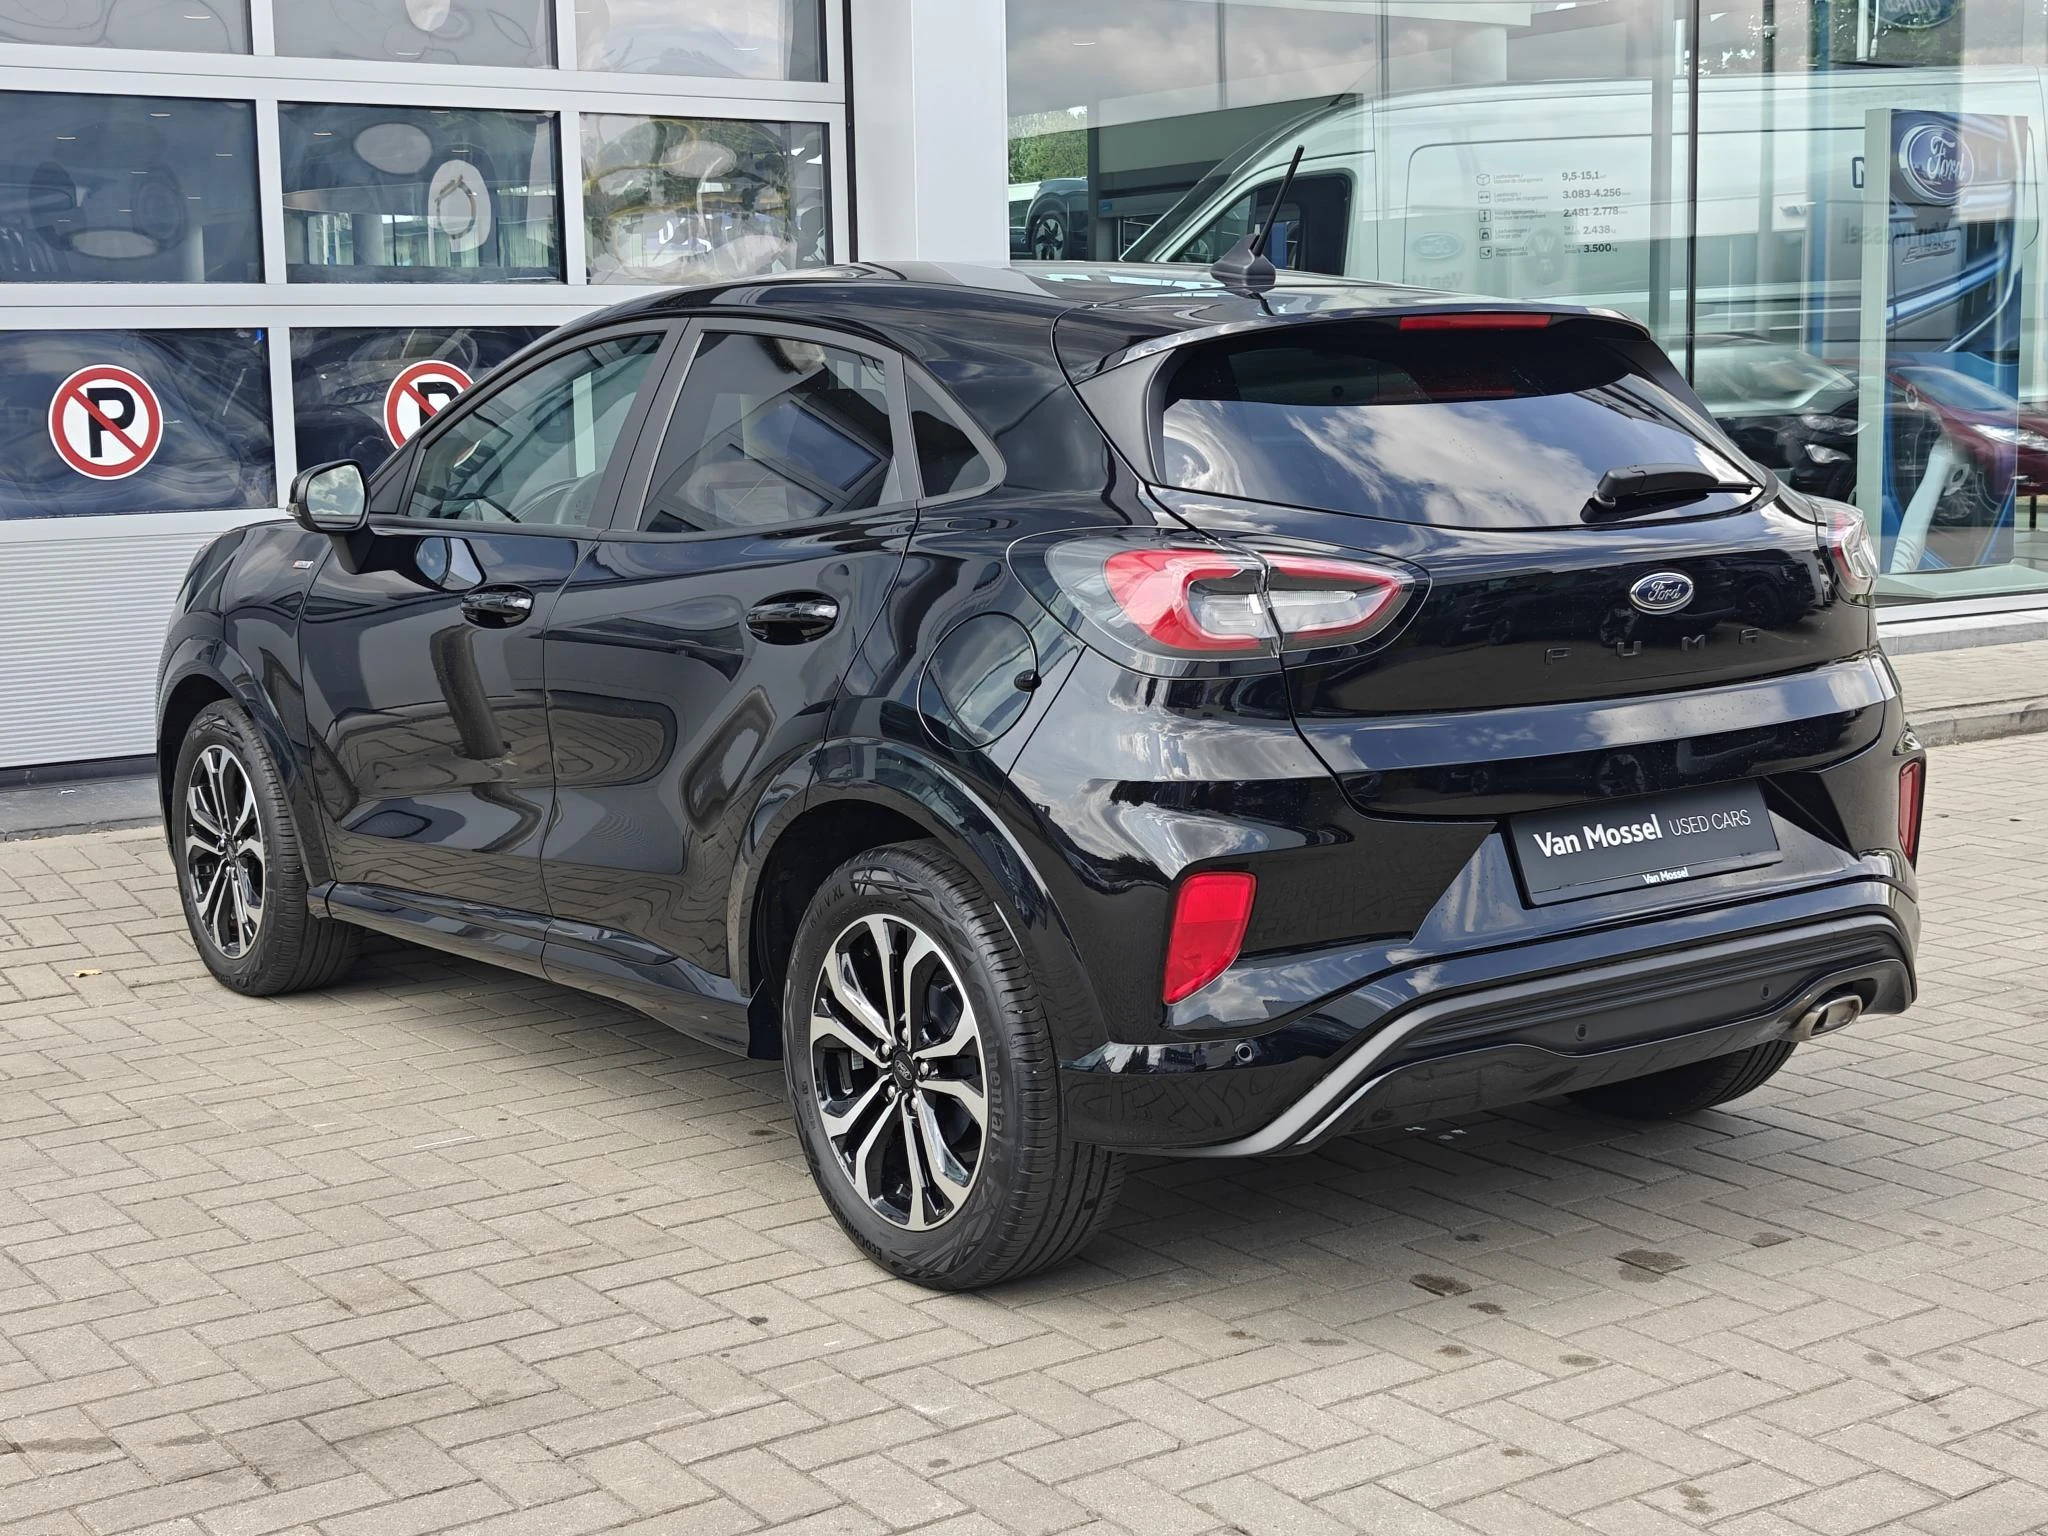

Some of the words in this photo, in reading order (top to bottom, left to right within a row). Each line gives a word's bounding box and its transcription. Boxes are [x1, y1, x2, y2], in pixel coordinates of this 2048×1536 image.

[1927, 135, 1965, 180] Ford
[1583, 225, 1611, 235] 2.438
[1583, 243, 1612, 253] 3.500
[86, 387, 136, 458] P
[1647, 580, 1682, 601] Ford
[1533, 831, 1582, 857] Van
[1583, 813, 1663, 850] Mossel
[1668, 815, 1709, 837] USED
[1711, 809, 1751, 831] CARS
[1642, 873, 1661, 884] Van
[1660, 866, 1689, 881] Mossel
